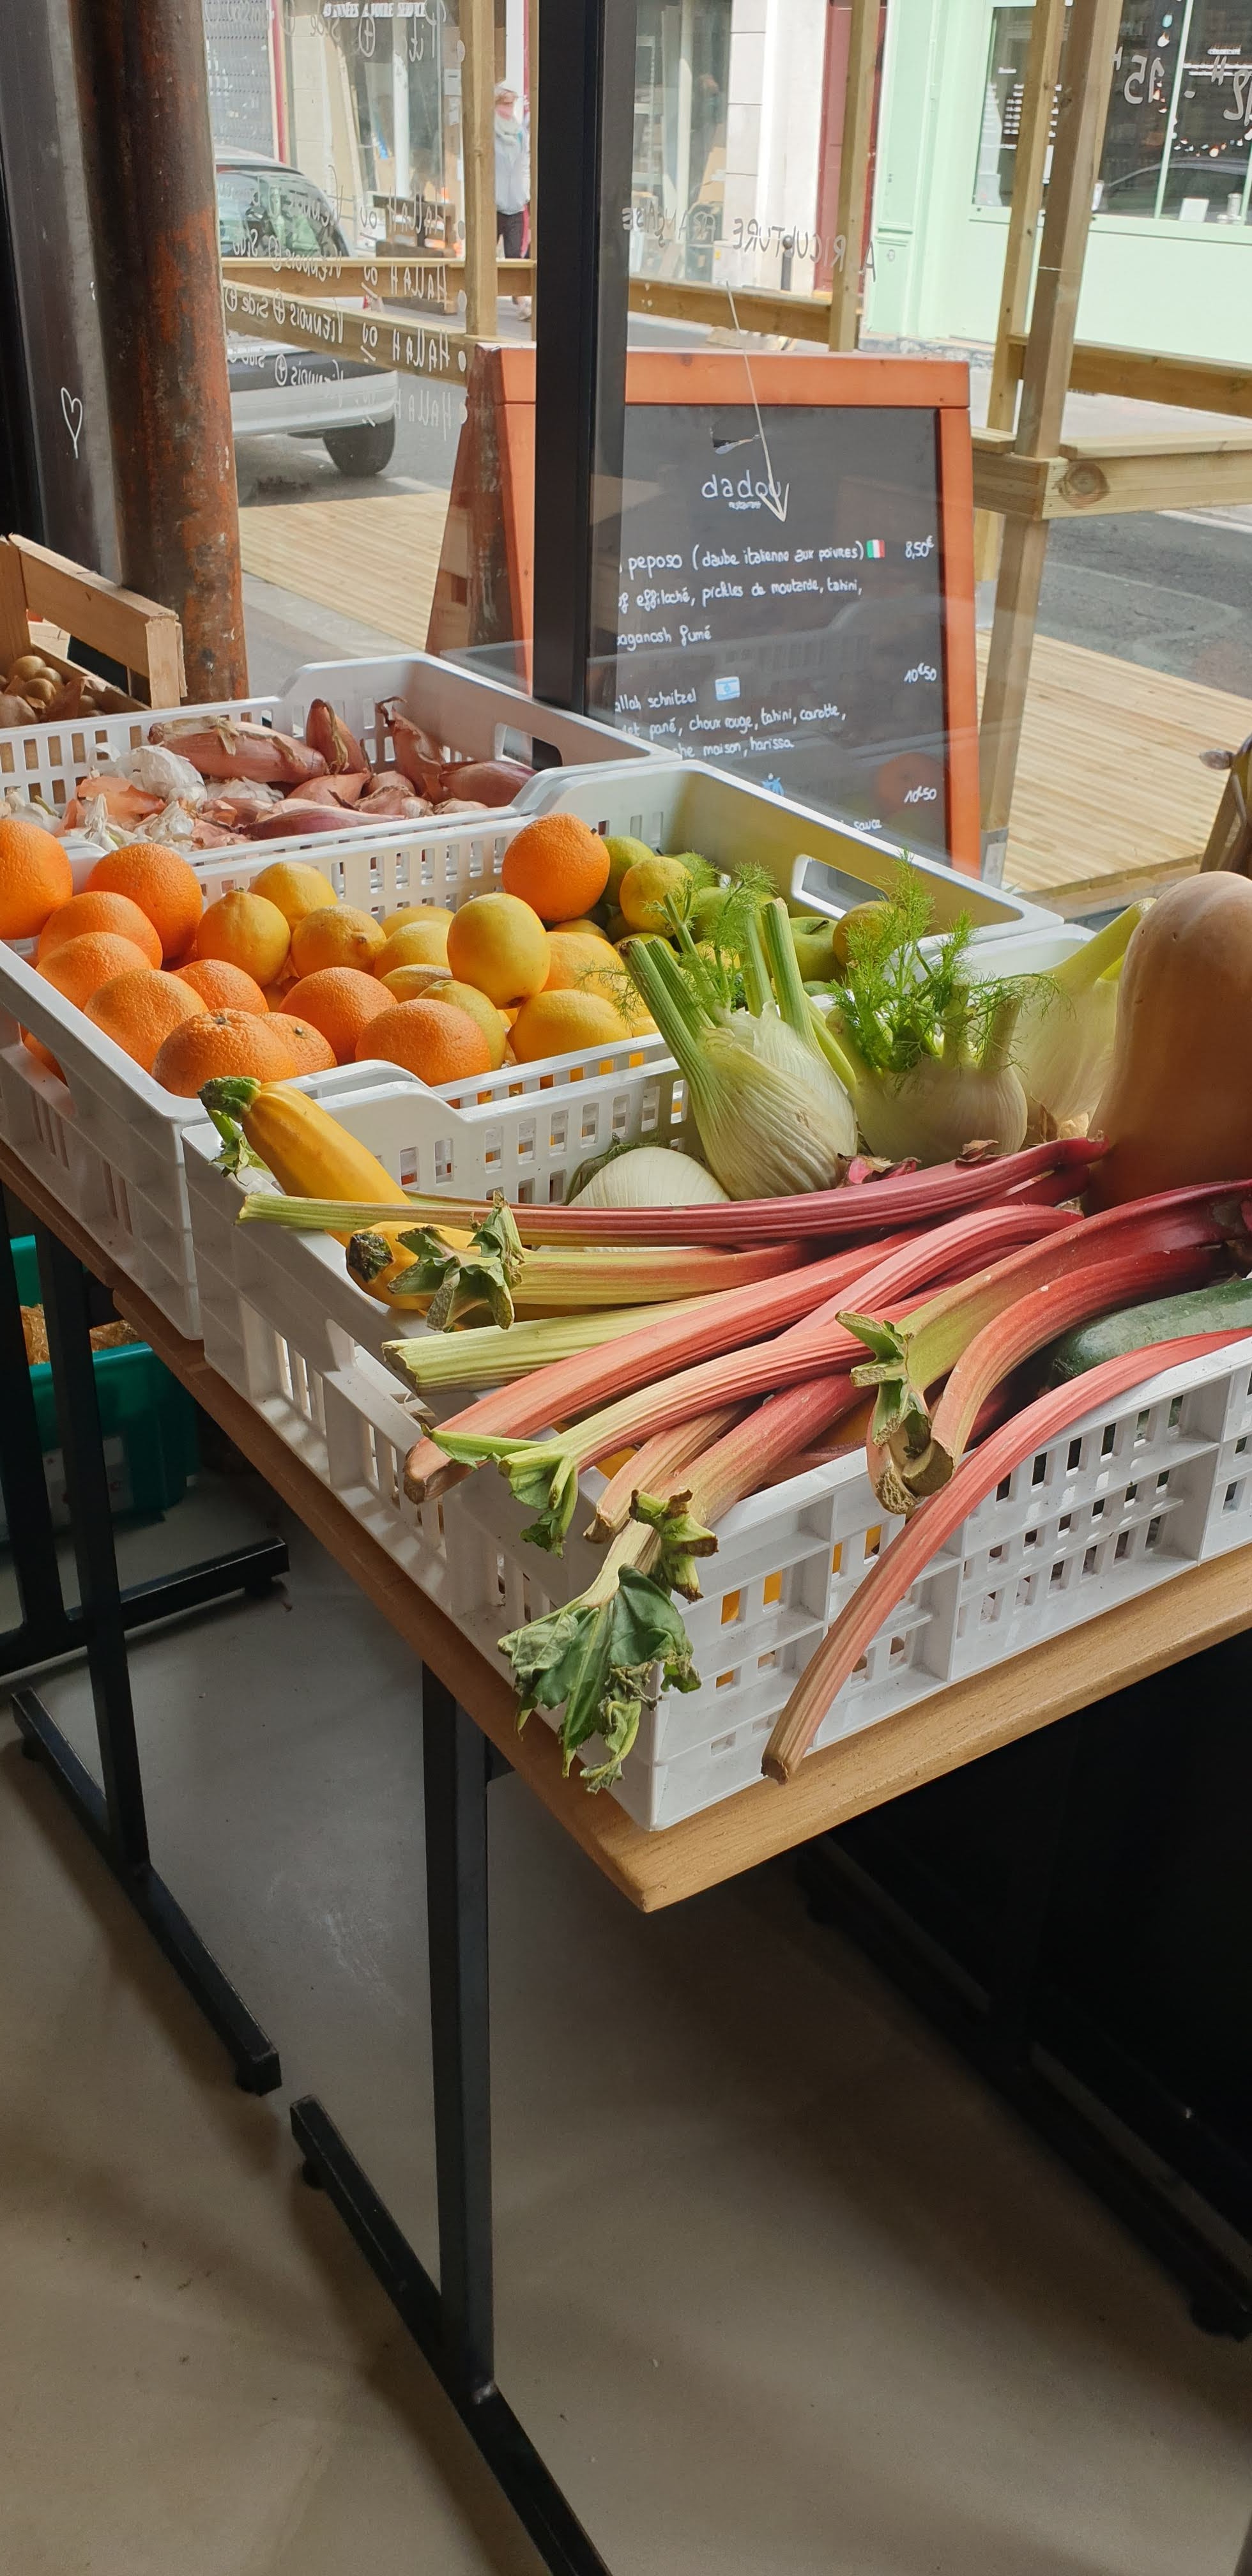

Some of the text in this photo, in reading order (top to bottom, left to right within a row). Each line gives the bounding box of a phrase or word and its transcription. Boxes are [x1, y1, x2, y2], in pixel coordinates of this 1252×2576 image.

[628, 554, 682, 580] peposo
[702, 581, 744, 608] pickles
[647, 687, 698, 709] schnitzel
[689, 714, 721, 732] choux
